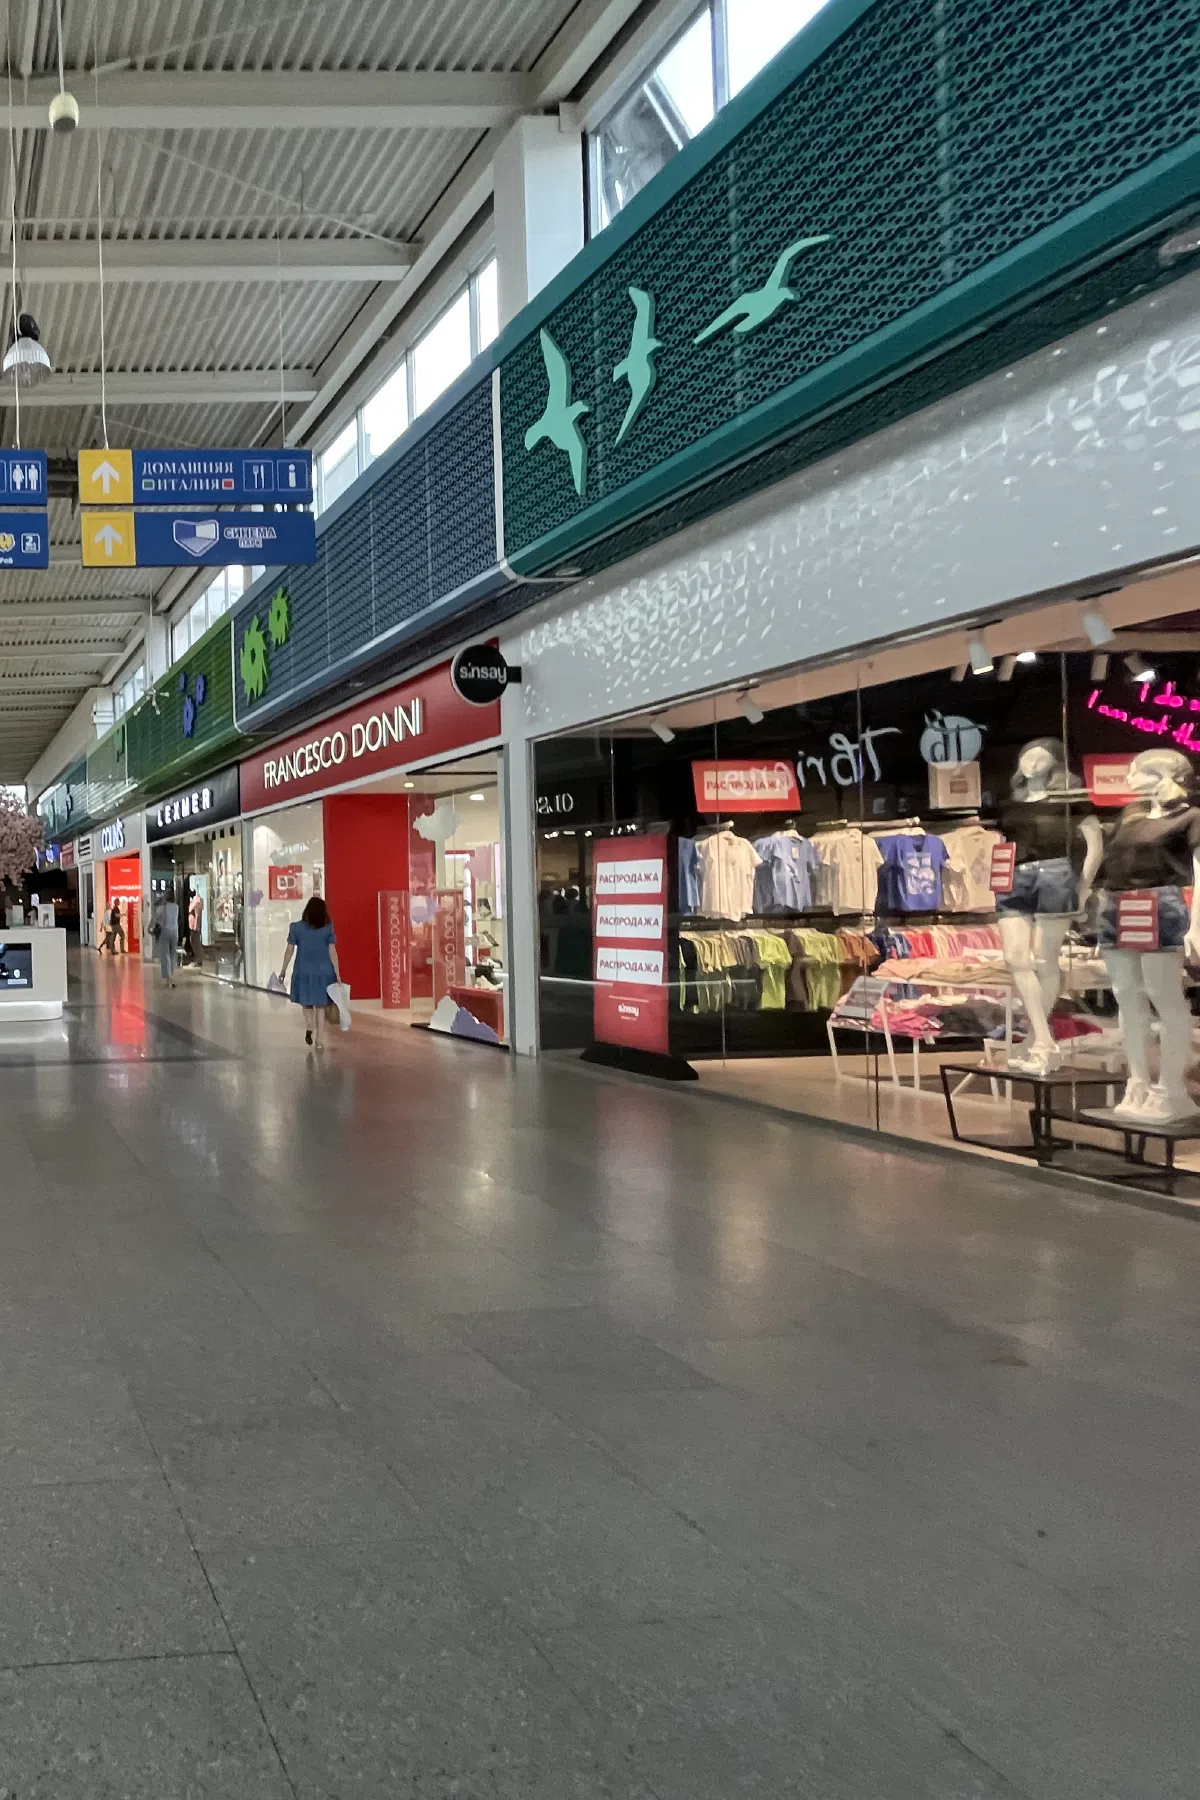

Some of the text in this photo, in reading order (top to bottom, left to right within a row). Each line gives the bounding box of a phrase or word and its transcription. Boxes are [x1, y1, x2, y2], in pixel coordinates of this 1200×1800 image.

[141, 461, 234, 476] ДОМАШНЯЯ
[158, 478, 220, 491] ИТАЛИЯ
[223, 526, 277, 539] СИНЕМА
[459, 662, 507, 684] sinsay
[264, 697, 421, 789] FRANCESCO DONNI
[157, 788, 211, 827] LEXMER
[599, 872, 659, 884] РАСПРОДАЖА
[599, 916, 659, 928] РАСПРОДАЖА
[599, 958, 660, 973] РАСПРОДАЖА
